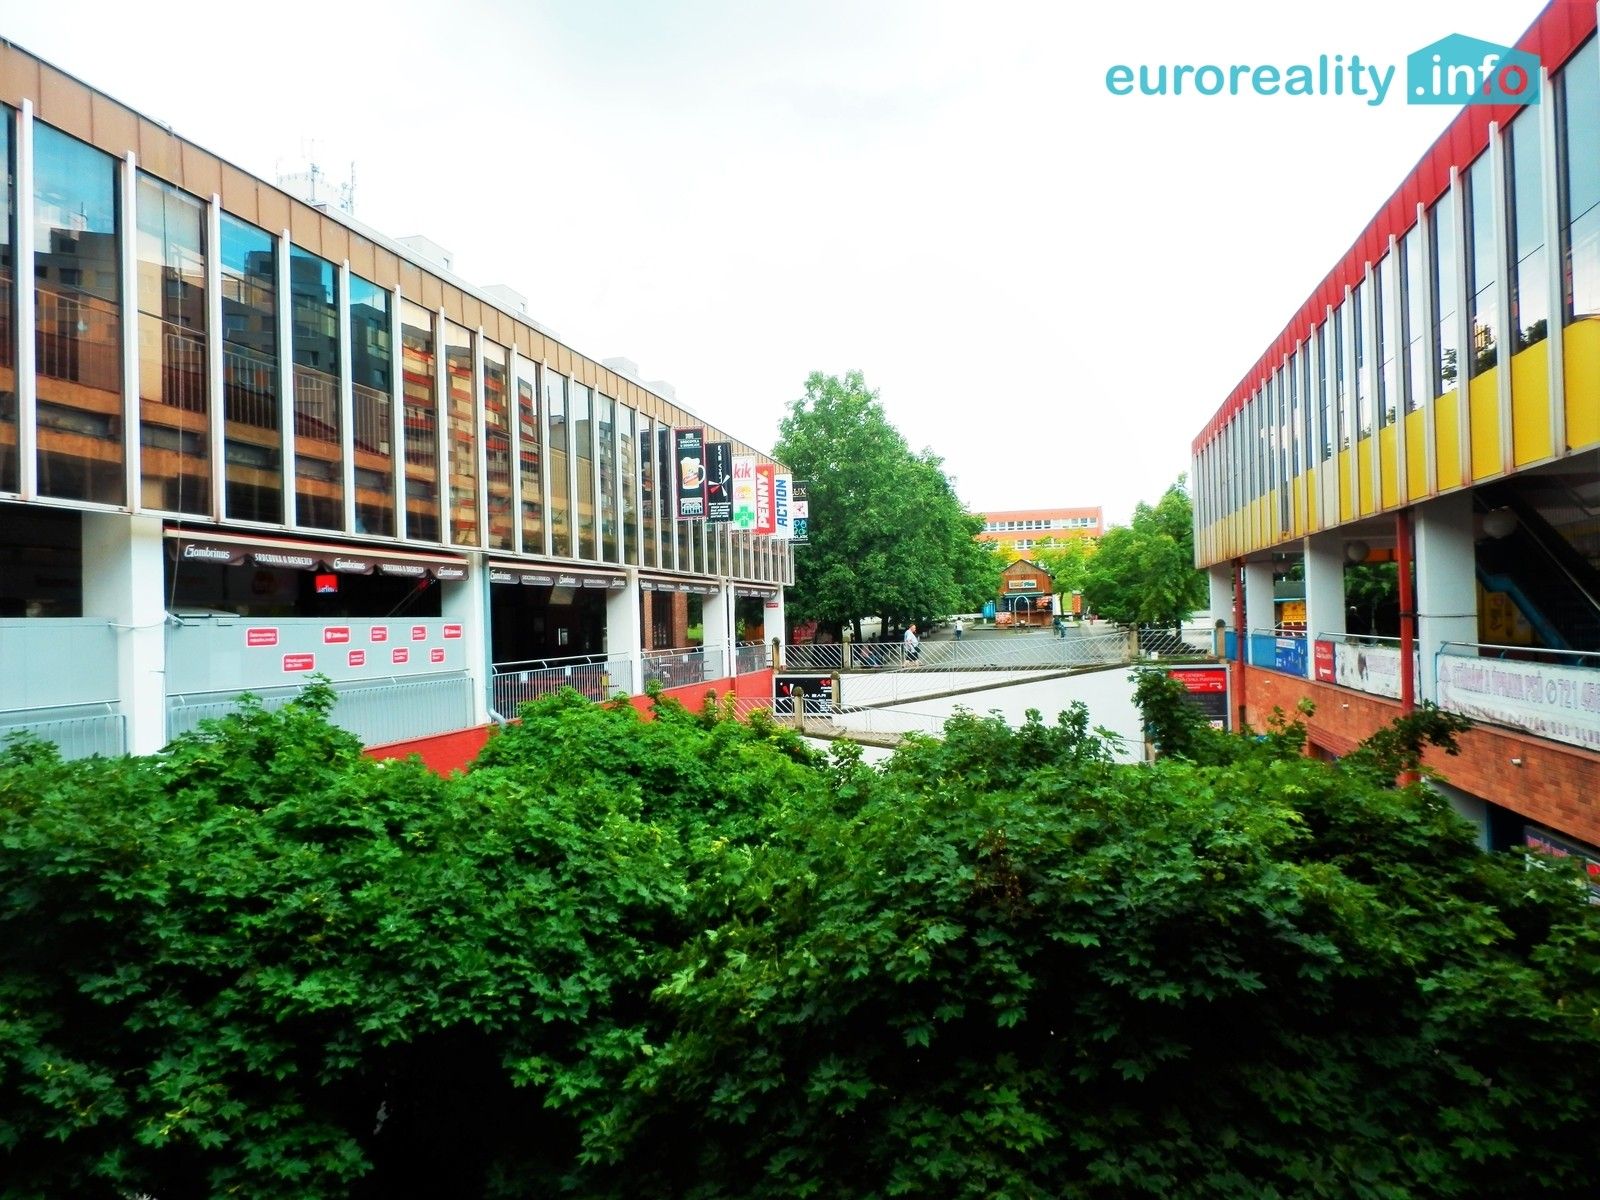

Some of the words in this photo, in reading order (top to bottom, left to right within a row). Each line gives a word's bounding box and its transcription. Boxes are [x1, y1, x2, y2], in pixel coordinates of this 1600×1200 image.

[734, 462, 751, 479] kik
[792, 487, 806, 496] UX
[757, 472, 770, 529] PENNY
[775, 479, 788, 527] ACTION
[184, 544, 231, 559] Gambrinus
